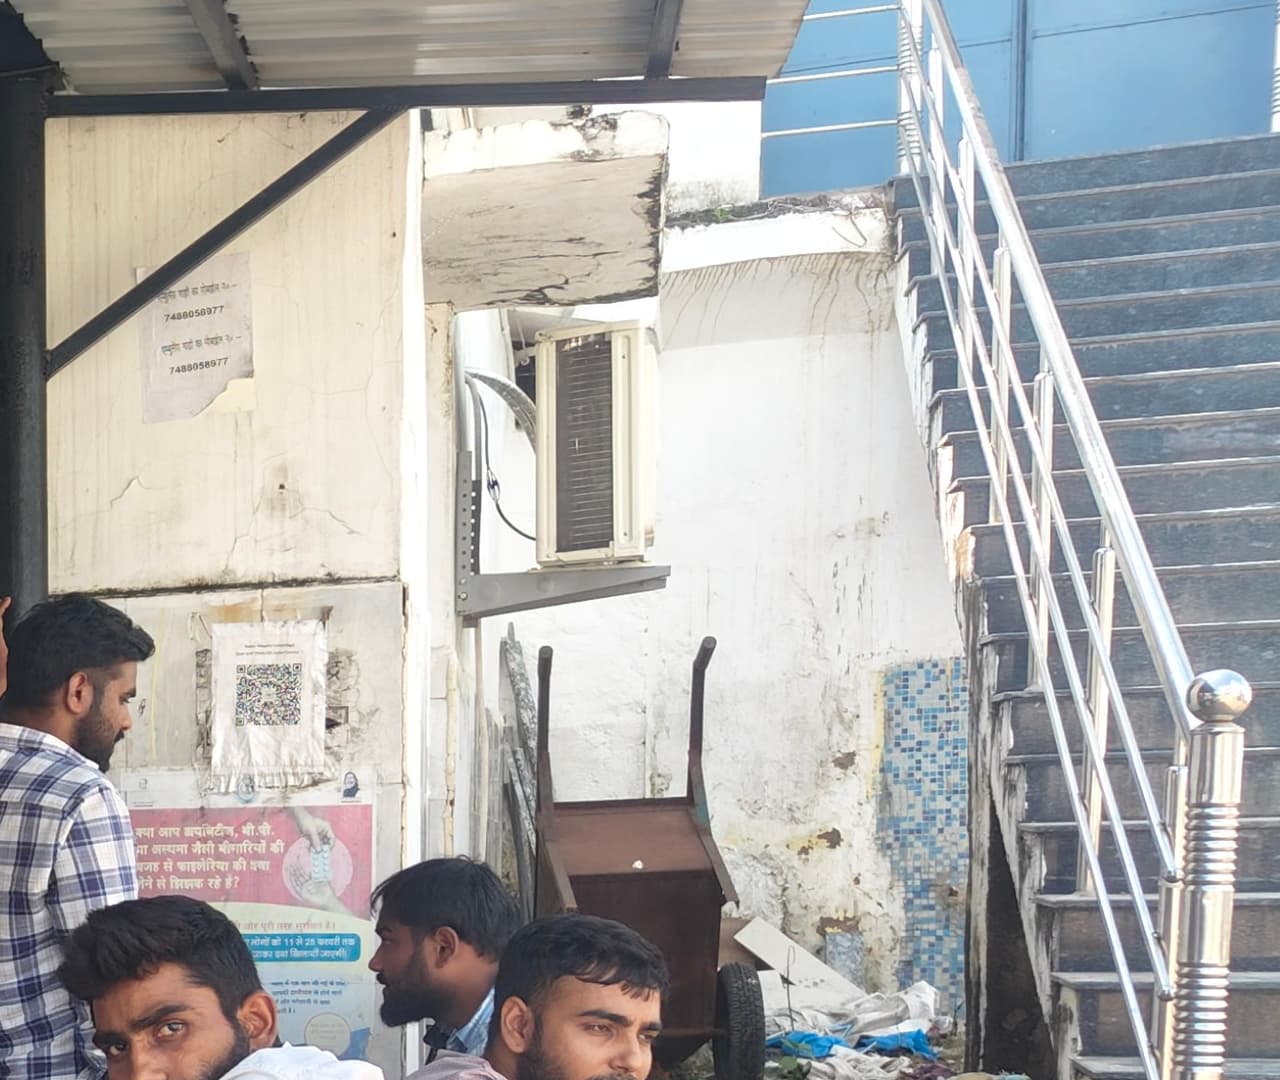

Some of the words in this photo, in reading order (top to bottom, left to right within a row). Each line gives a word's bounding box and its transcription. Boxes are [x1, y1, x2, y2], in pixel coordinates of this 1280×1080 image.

[164, 305, 225, 322] 7488058977
[158, 825, 180, 838] आप
[270, 839, 284, 854] की
[163, 860, 174, 872] से
[232, 859, 247, 872] की
[156, 877, 166, 889] से
[207, 876, 222, 889] रहे
